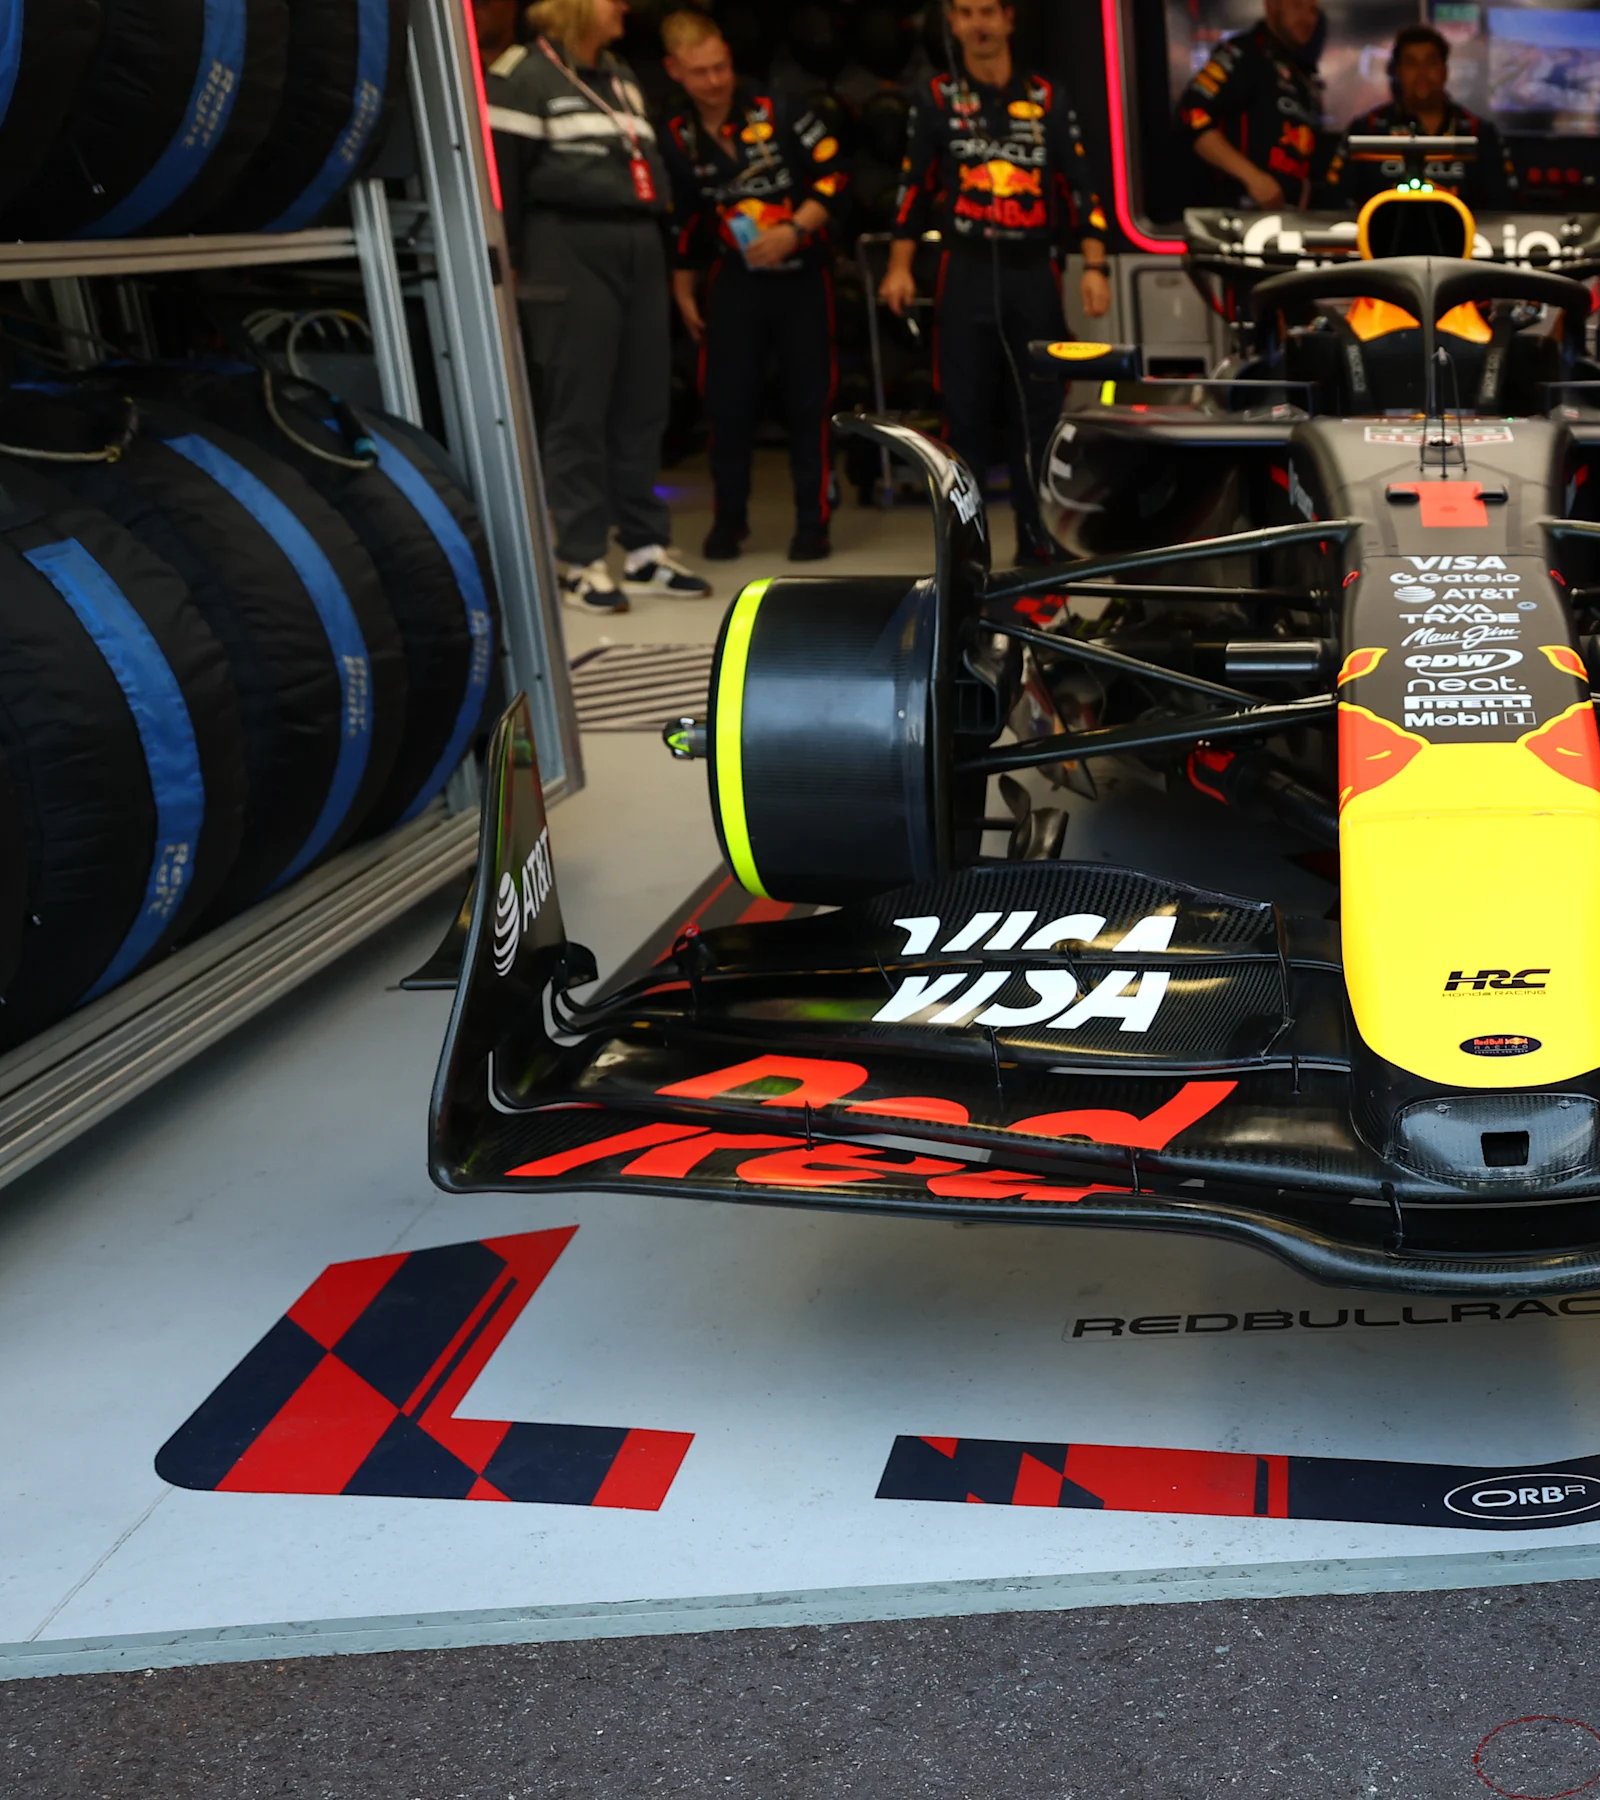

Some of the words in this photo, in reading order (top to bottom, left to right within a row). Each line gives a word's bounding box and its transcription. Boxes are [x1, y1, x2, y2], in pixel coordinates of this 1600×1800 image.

[950, 138, 1048, 166] ORACLE
[1401, 556, 1507, 570] VISA
[1419, 573, 1521, 584] Gate.io
[1442, 588, 1520, 600] AT&T
[1426, 604, 1493, 613] AVA
[1399, 613, 1521, 624] TRADE
[1401, 627, 1459, 647] Maui
[1462, 625, 1521, 650] Jim
[1407, 676, 1527, 693] neat.
[1404, 694, 1532, 709] PIRELLI
[1404, 711, 1499, 727] Mobil
[522, 826, 552, 932] AT&T
[871, 911, 1178, 1032] VISA
[1444, 969, 1551, 991] HRC
